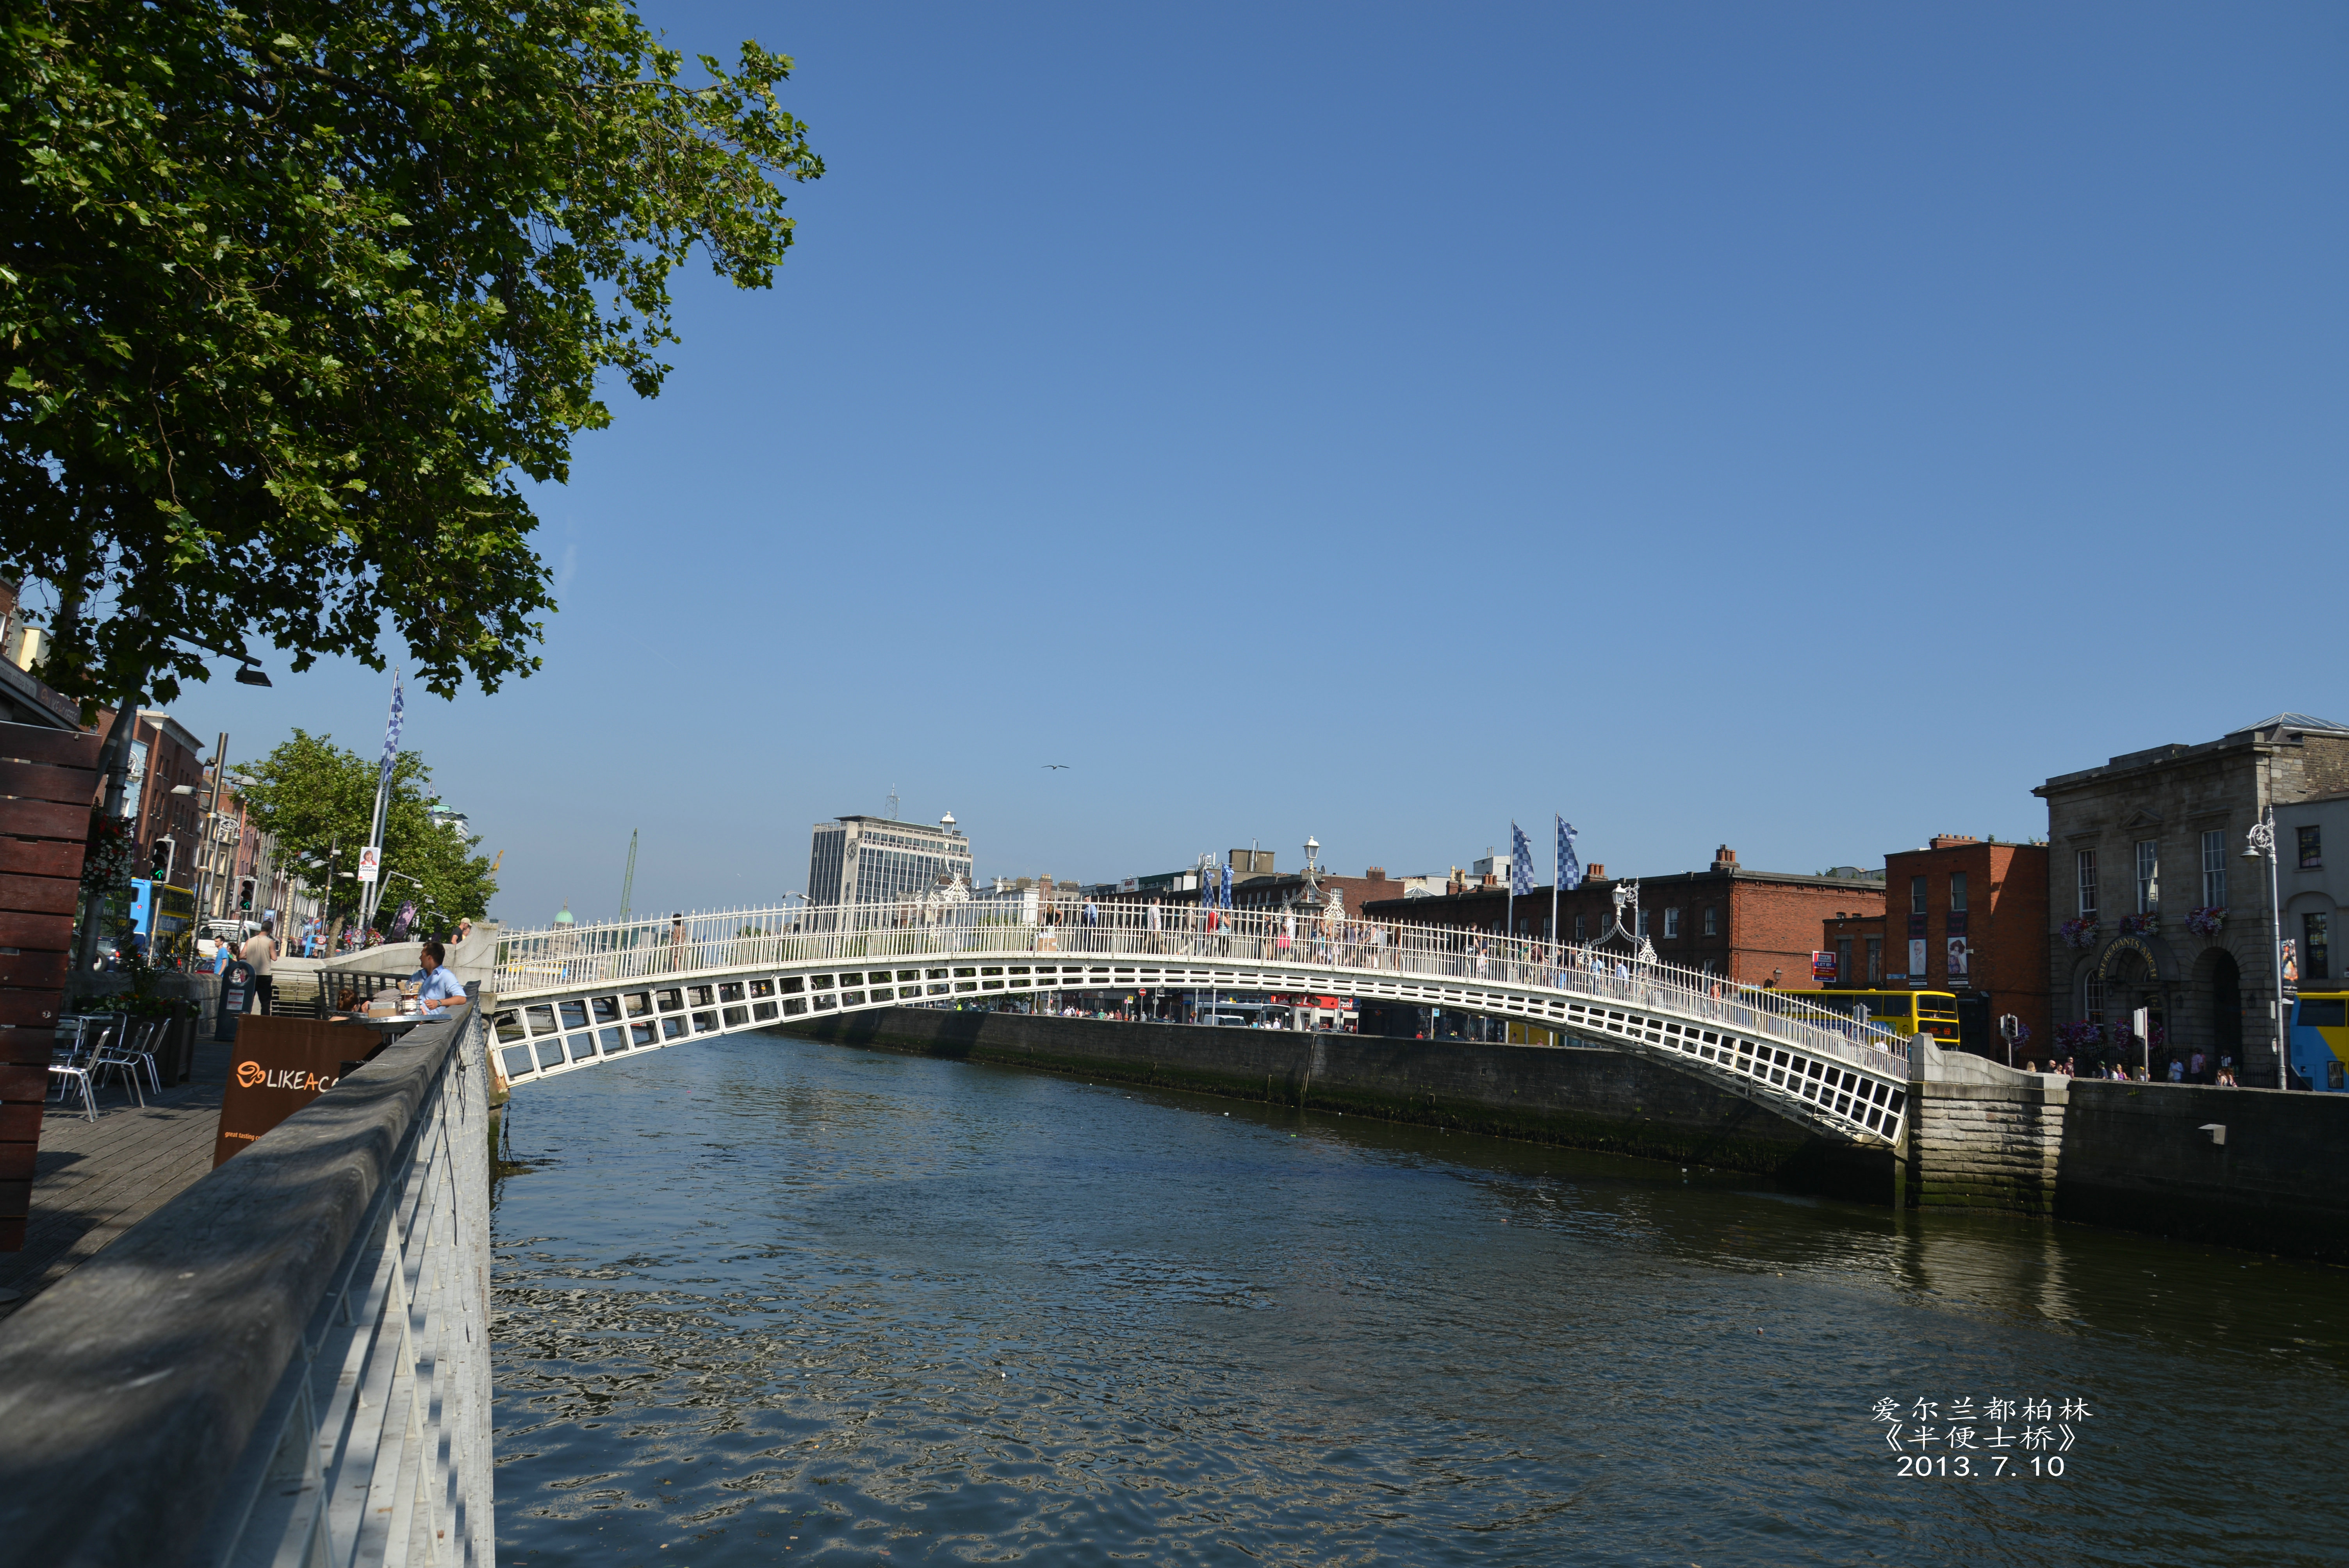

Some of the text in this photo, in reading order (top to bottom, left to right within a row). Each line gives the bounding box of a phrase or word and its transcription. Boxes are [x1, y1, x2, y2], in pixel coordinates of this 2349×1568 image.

[2099, 937, 2157, 978] MERCHANTS ARCH
[239, 1133, 254, 1141] tasting
